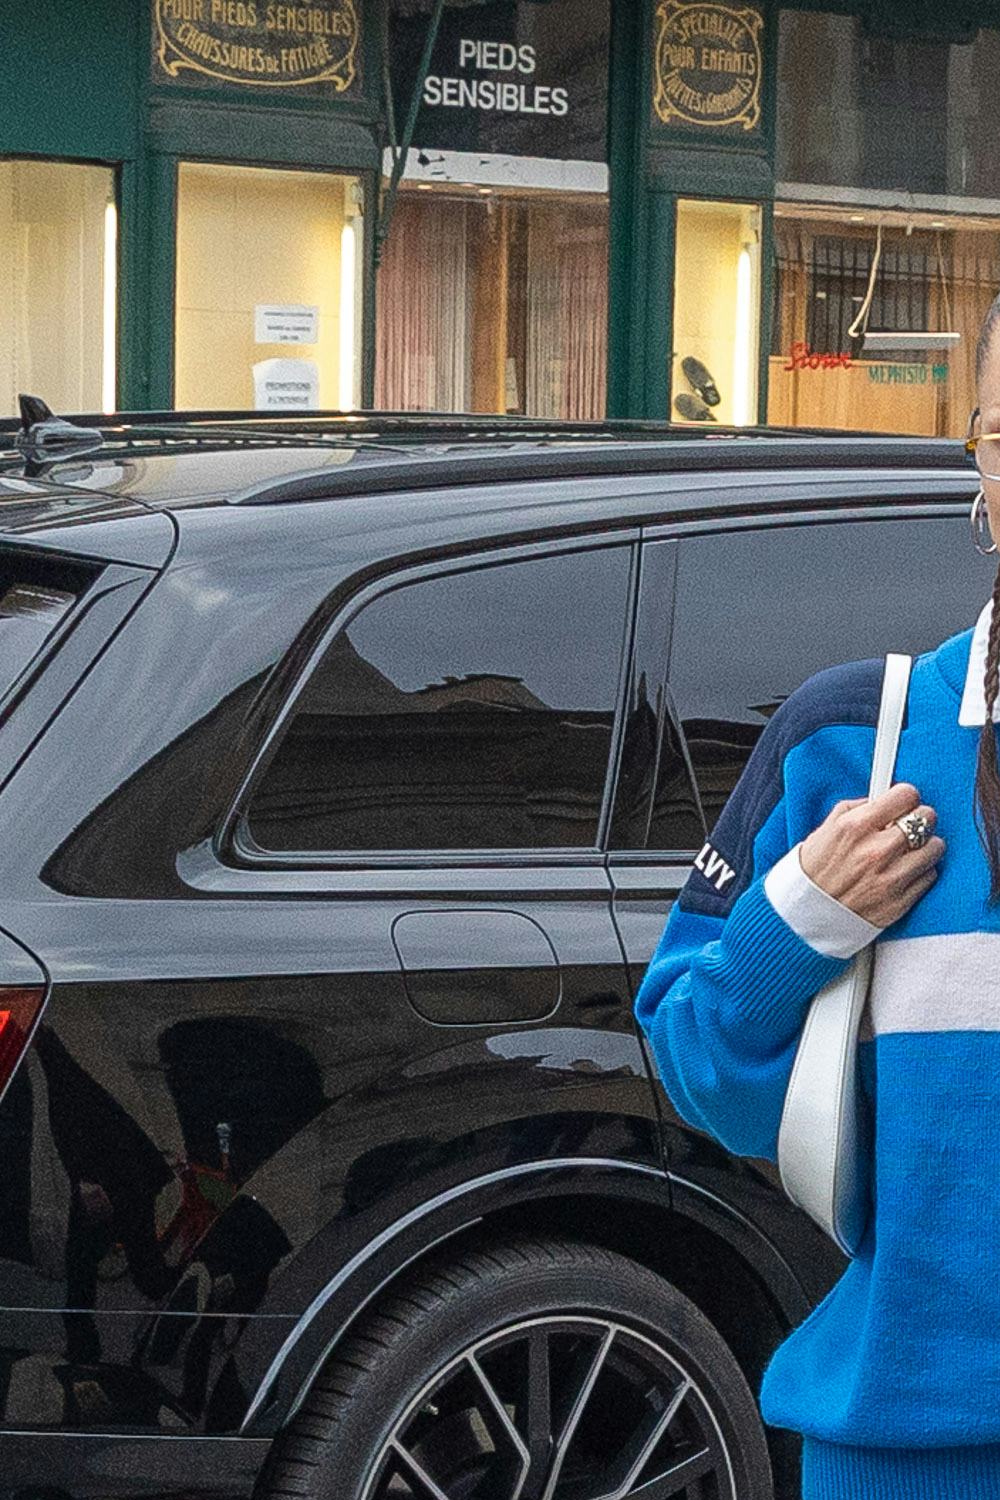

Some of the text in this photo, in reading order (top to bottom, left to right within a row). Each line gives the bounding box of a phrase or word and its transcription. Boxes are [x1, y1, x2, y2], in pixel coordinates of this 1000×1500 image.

[162, 0, 353, 36] POUR PIEDS SENSIBLES
[177, 22, 265, 73] CHAUSSURES
[459, 39, 536, 74] PIEDS
[662, 43, 756, 76] POUR ENFANTS
[423, 76, 568, 116] SENSIBLES
[869, 364, 927, 384] MEPHISTO
